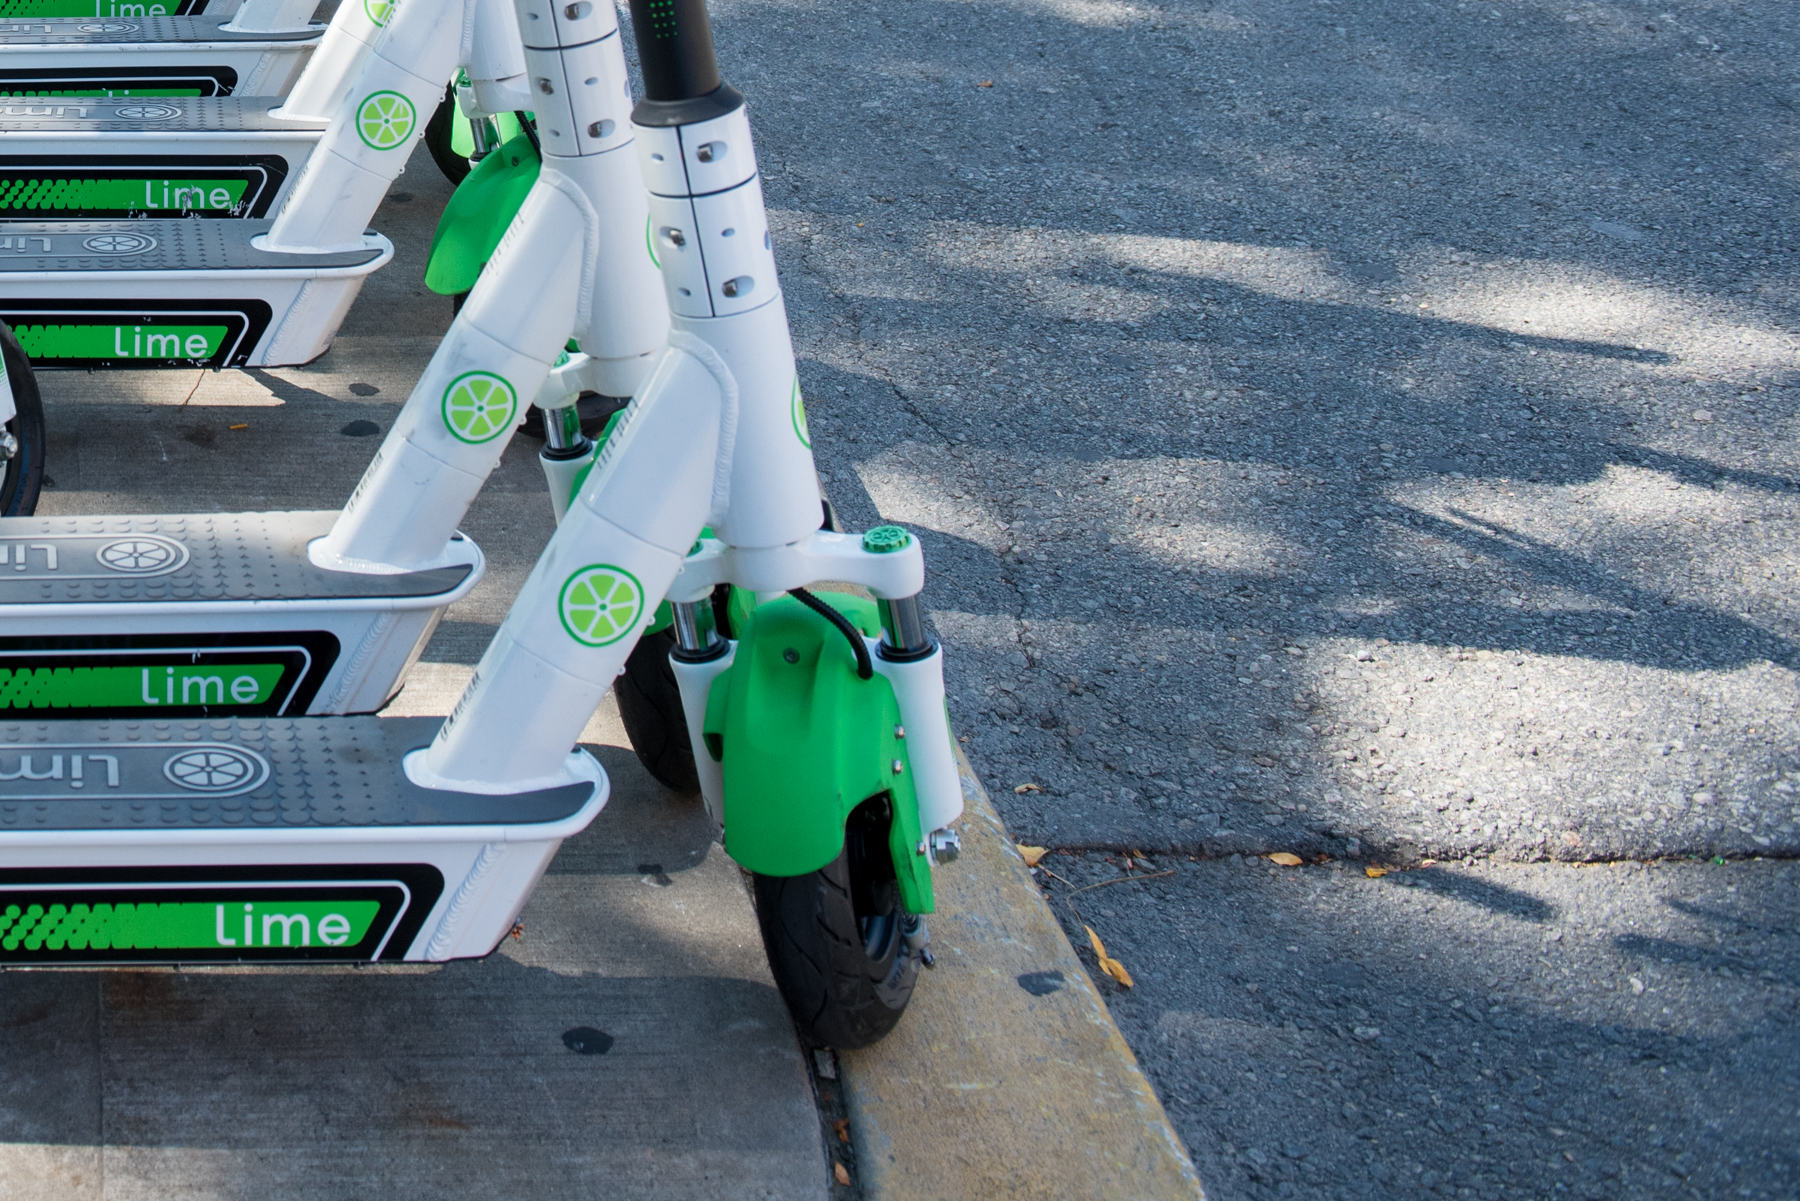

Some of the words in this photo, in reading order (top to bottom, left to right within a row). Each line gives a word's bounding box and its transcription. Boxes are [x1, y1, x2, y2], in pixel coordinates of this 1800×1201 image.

[145, 180, 231, 209] Lime
[114, 327, 208, 358] Lime
[141, 668, 260, 704] Lime
[215, 903, 353, 946] Lime
